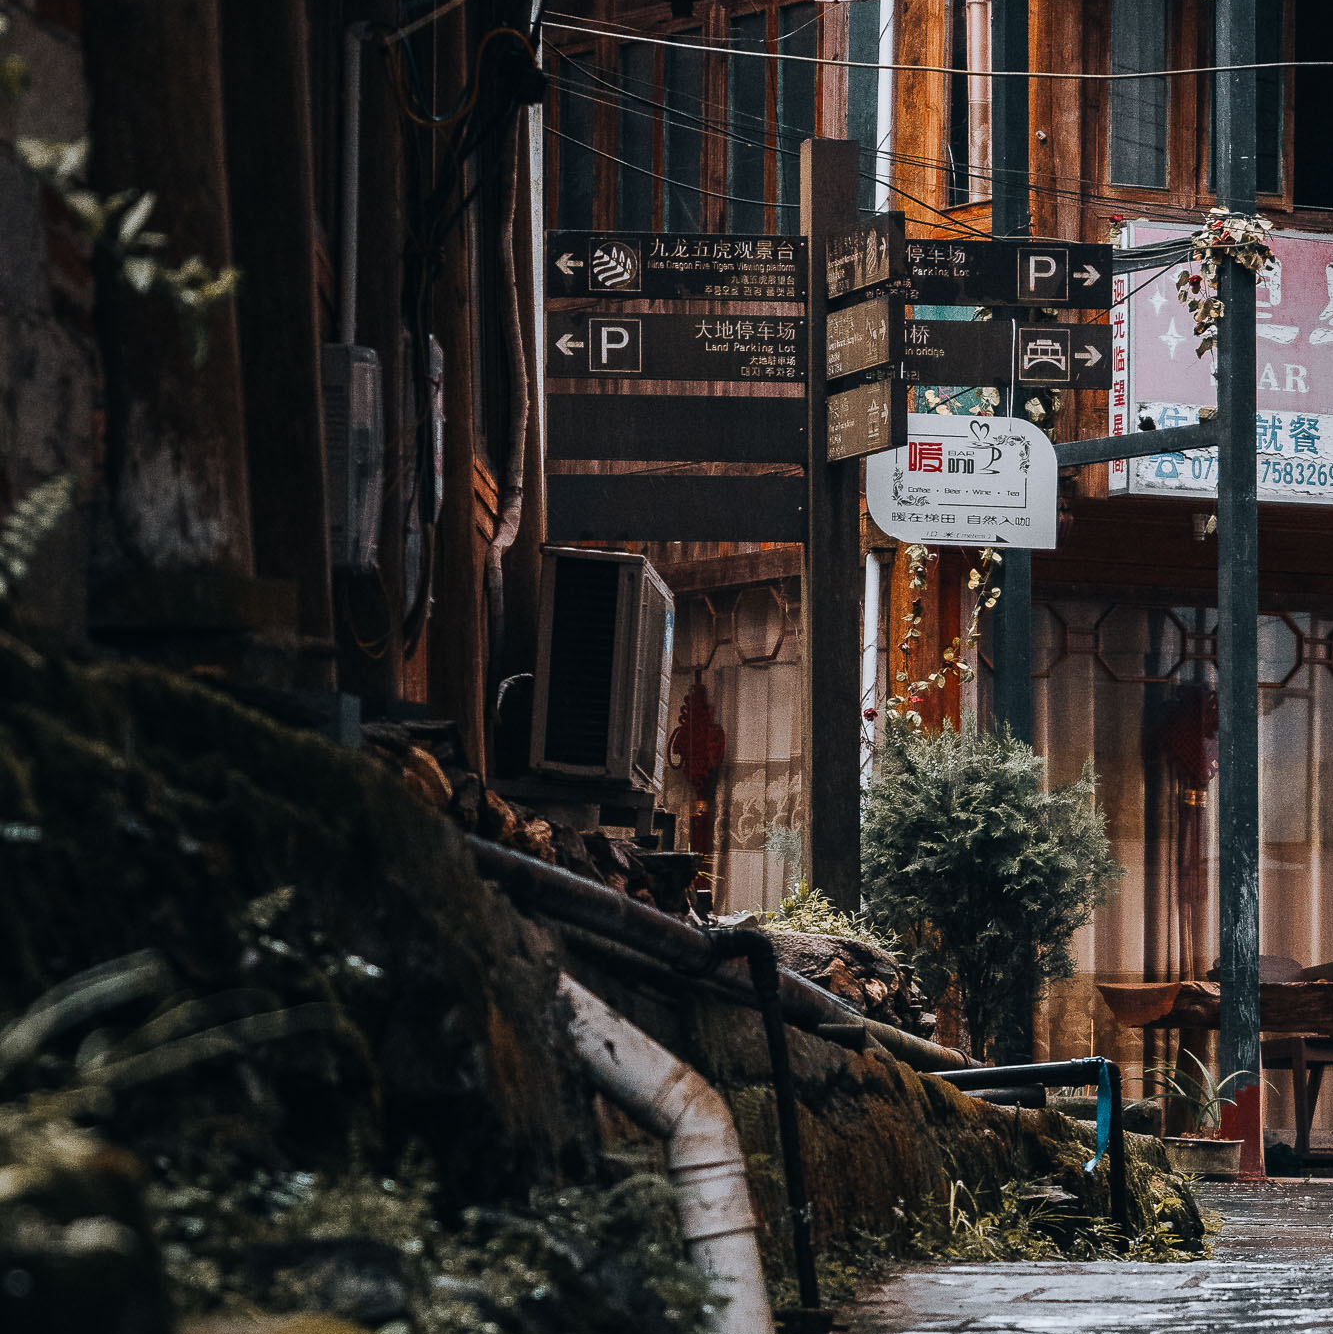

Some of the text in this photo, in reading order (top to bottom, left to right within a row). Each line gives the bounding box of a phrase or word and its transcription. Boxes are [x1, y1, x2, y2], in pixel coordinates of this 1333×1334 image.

[650, 237, 796, 261] 九龙五虎观景台
[904, 243, 967, 265] 停车场
[647, 259, 796, 274] Nine Dragon Five Tigers Viewing platform
[912, 265, 971, 278] Parking Lot
[1029, 255, 1057, 292] P
[694, 319, 797, 341] 大地停车场
[903, 322, 931, 345] 桥
[600, 325, 630, 364] P
[705, 341, 797, 354] Land Parking Lot
[915, 347, 945, 359] bridge
[1157, 406, 1321, 456] 住就餐
[907, 486, 932, 494] Coffee
[944, 487, 962, 495] Beer
[972, 488, 992, 496] Wine
[891, 512, 1031, 527] 暖在梯田 自然入咖
